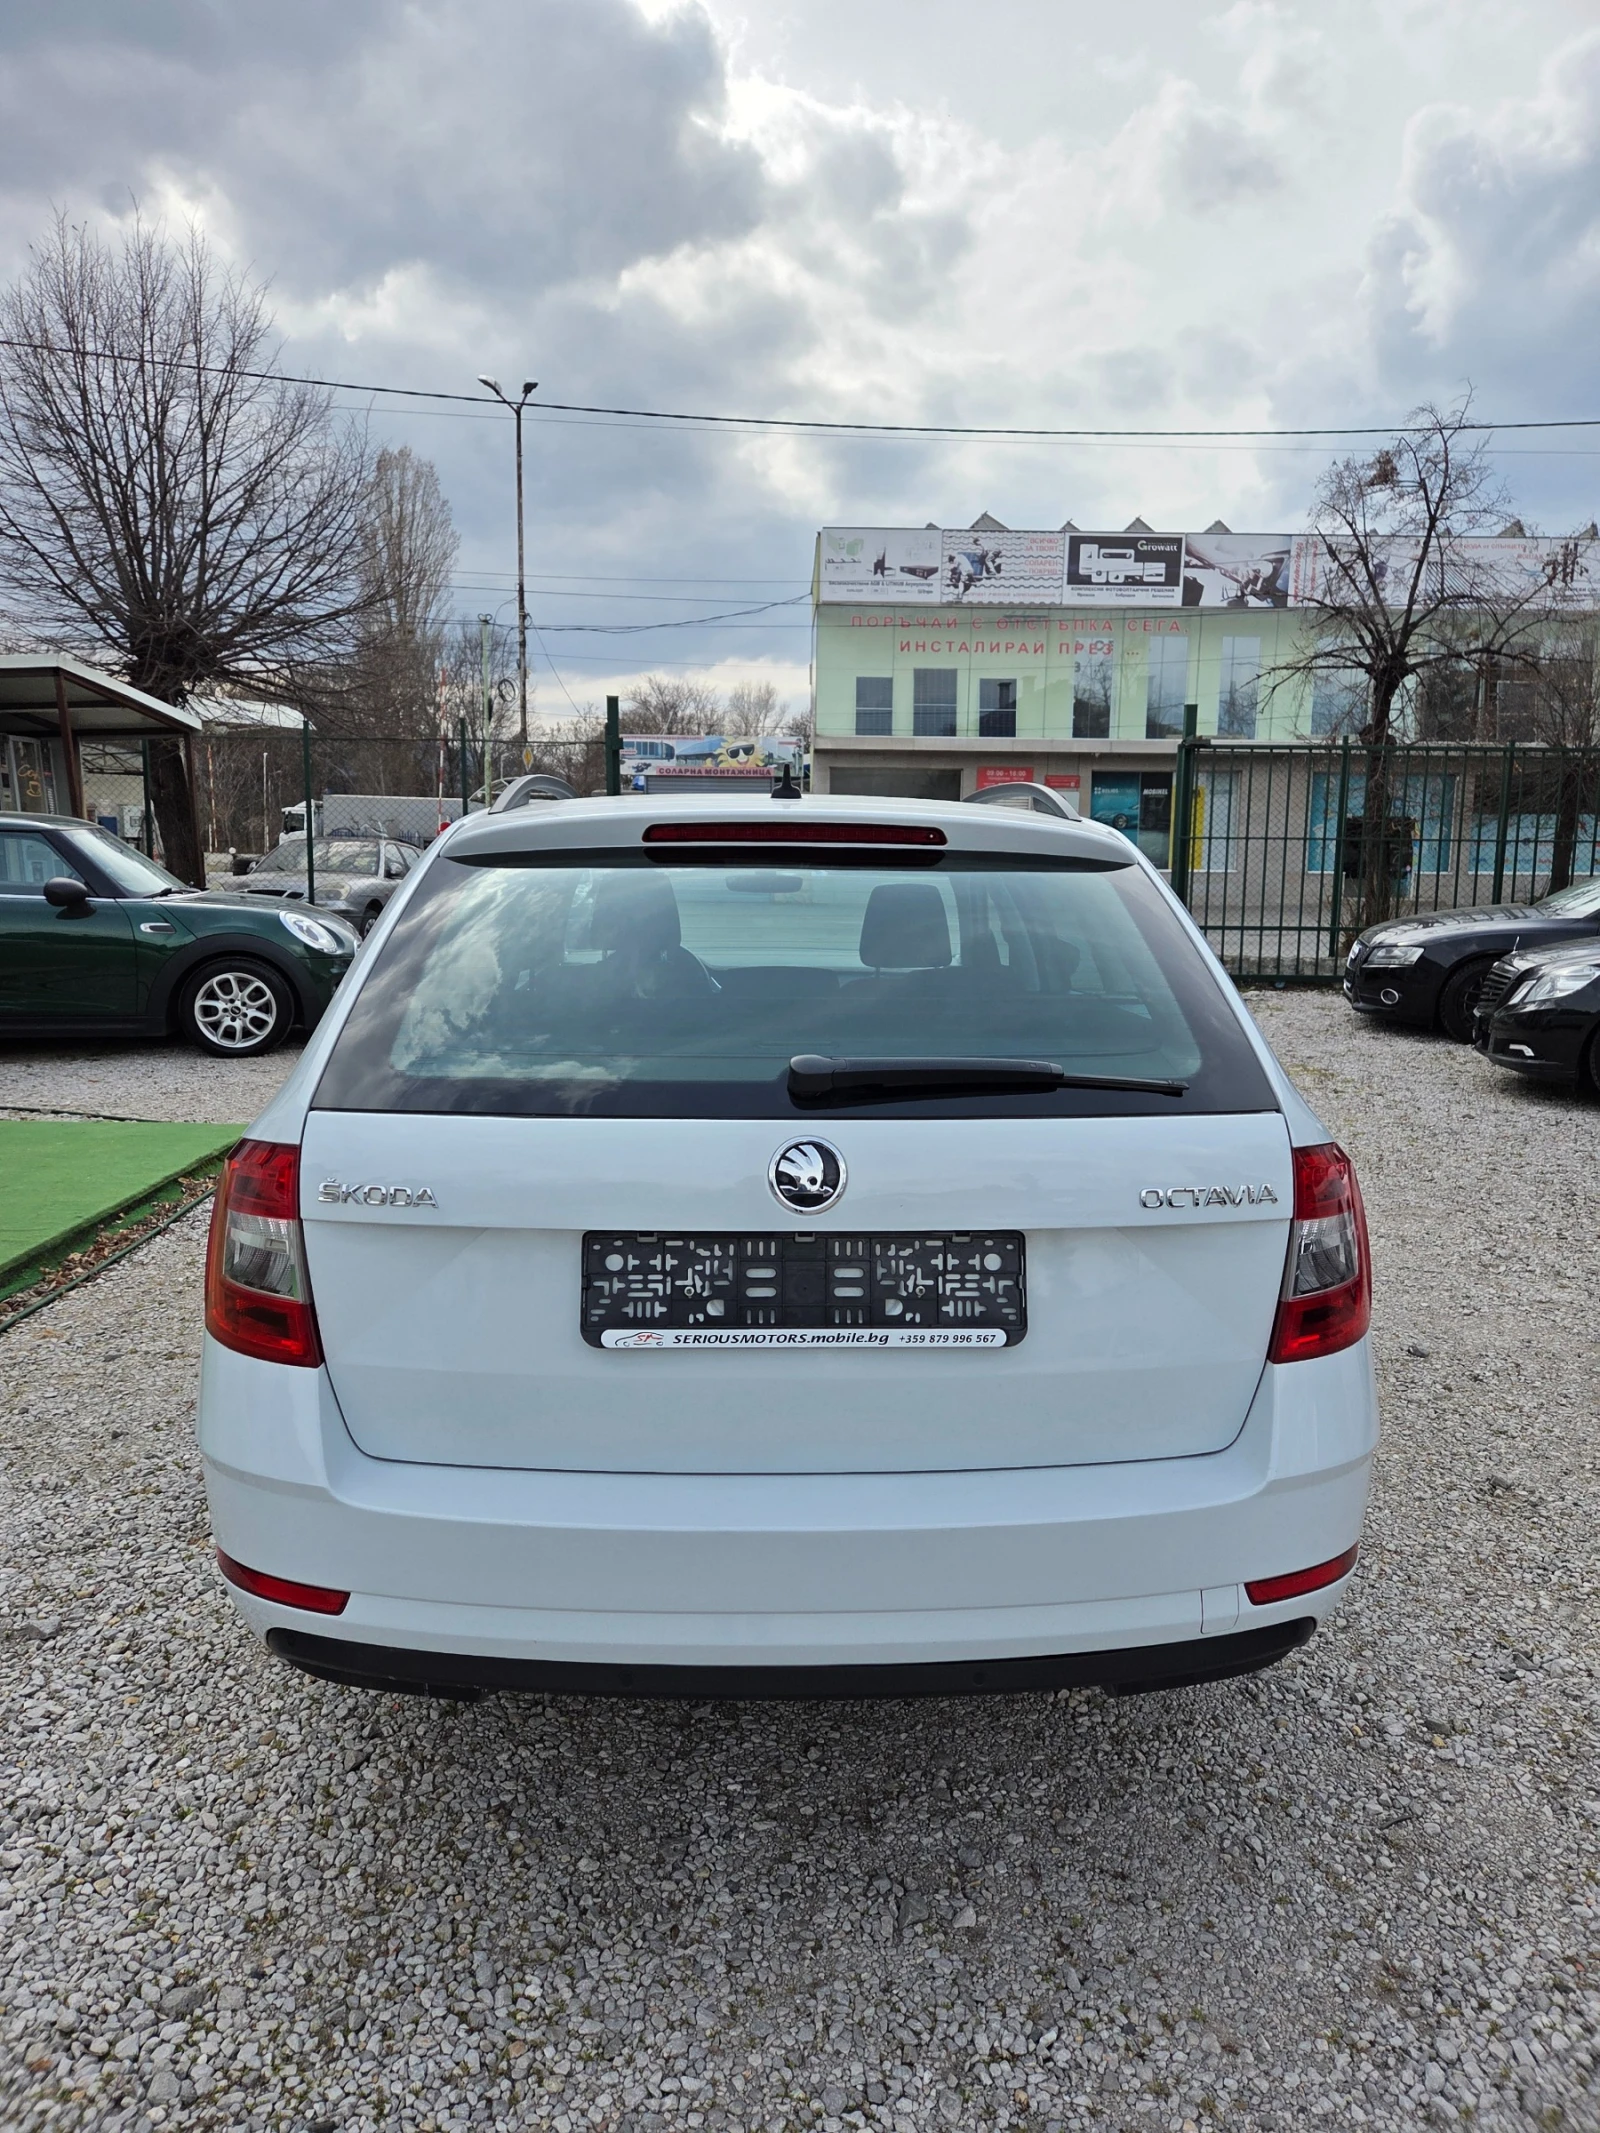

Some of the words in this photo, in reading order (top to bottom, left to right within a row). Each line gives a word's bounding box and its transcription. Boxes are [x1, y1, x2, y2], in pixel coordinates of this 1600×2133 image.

[1137, 539, 1178, 552] Growatt
[851, 615, 958, 629] ПОРЪЧАЙ
[996, 618, 1113, 631] ОТСТЪПКА
[899, 639, 1045, 655] ИНСТАЛИРАЙ
[1059, 642, 1113, 655] ПРЕЗ
[658, 766, 702, 776] СОЛАРНА
[704, 767, 772, 776] МОНТАЖНИЦА
[317, 1177, 440, 1209] ŠKODA
[1139, 1183, 1279, 1209] OCTAVIA
[672, 1332, 890, 1345] SERIOUSMOTORS.mobile.bg
[899, 1334, 926, 1344] +359
[929, 1335, 949, 1344] 879
[952, 1335, 972, 1344] 996
[976, 1335, 996, 1344] 567
